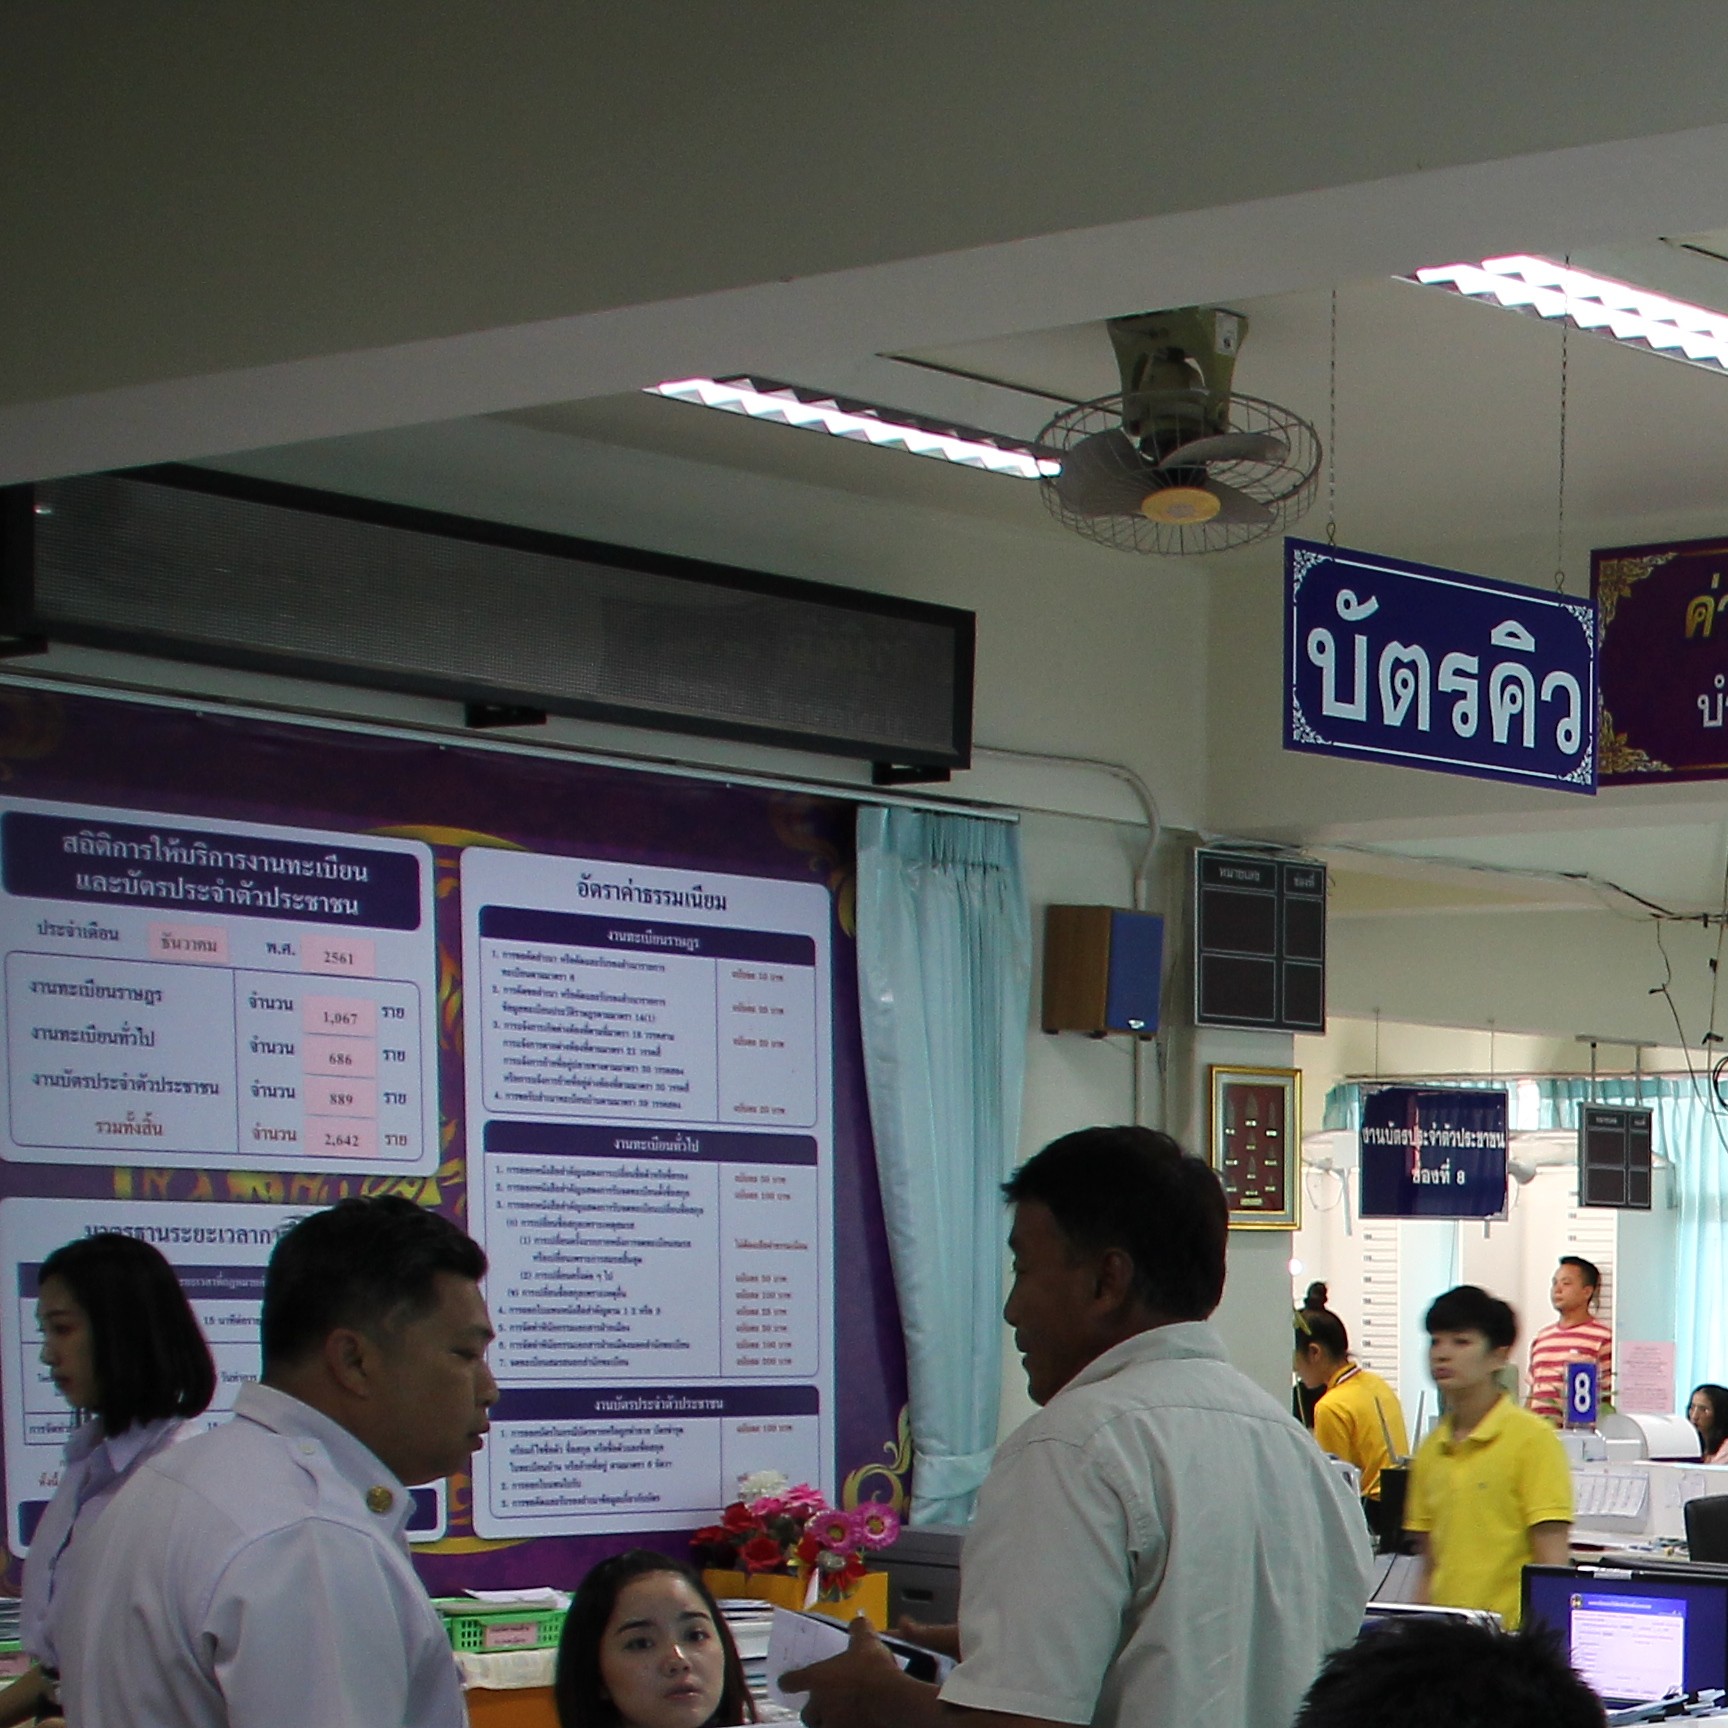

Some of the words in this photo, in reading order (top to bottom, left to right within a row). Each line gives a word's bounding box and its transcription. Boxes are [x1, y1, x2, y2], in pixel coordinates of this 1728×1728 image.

[1308, 590, 1583, 755] บัตรคิว
[63, 831, 368, 882] สถิติการให้บริการงานทะเบียน
[76, 870, 359, 916] และบัตรประจำตัวประชาชน
[577, 873, 726, 911] อัตราค่าธรรมเนียม
[267, 941, 296, 956] พ.ศ.
[323, 950, 354, 966] 2561
[249, 992, 293, 1011] จำนวน
[322, 1009, 358, 1026] 1,067
[381, 1003, 405, 1019] ราย
[250, 1037, 295, 1055] จำนวน
[328, 1052, 353, 1066] 686
[383, 1047, 406, 1062] ราย
[251, 1080, 296, 1098] จำนวน
[383, 1090, 407, 1105] ราย
[252, 1124, 297, 1142] จำนวน
[324, 1133, 360, 1147] 2,642
[385, 1132, 407, 1146] ราย
[1574, 1372, 1590, 1413] 8
